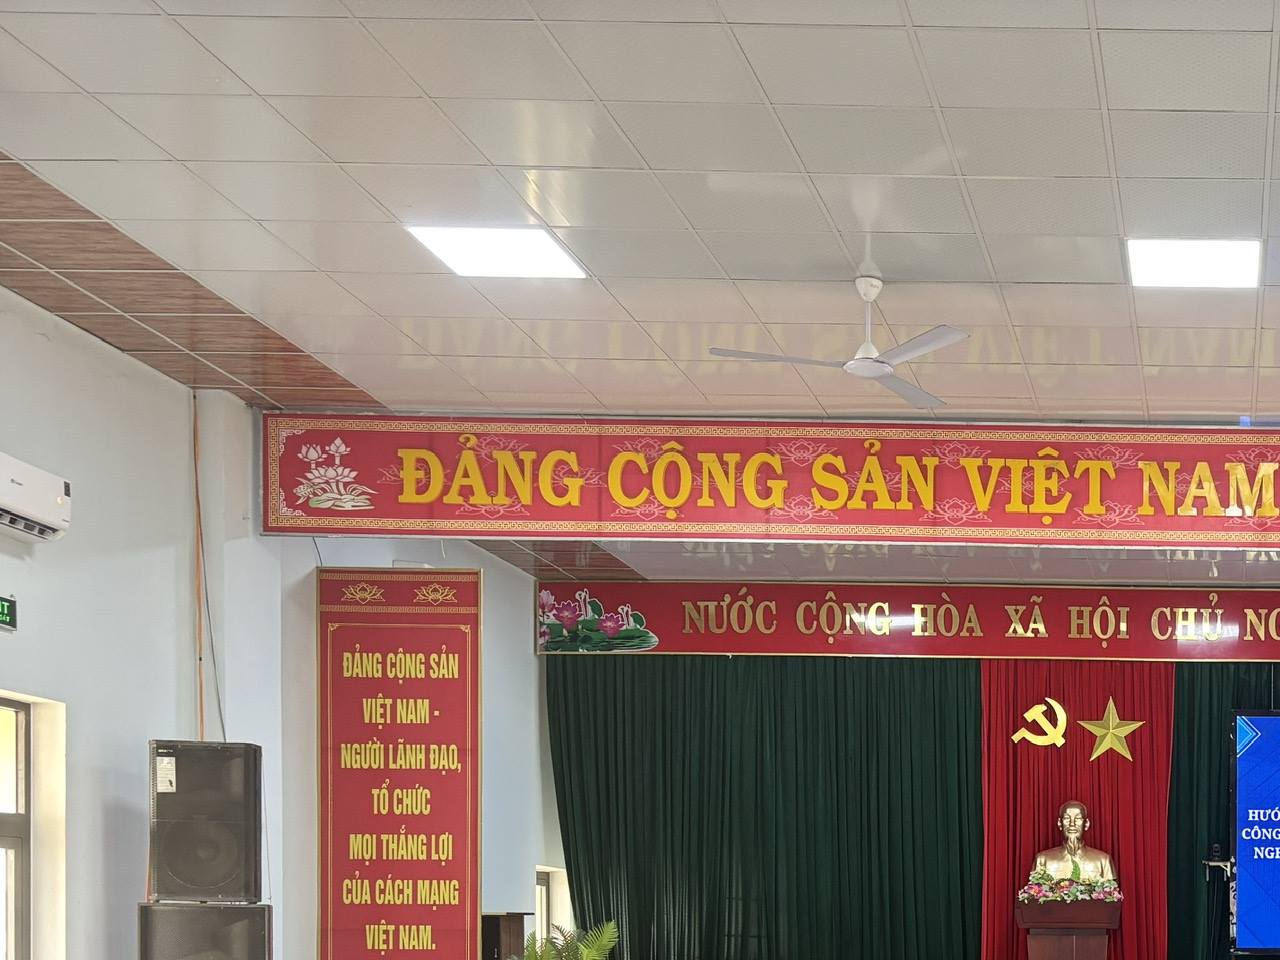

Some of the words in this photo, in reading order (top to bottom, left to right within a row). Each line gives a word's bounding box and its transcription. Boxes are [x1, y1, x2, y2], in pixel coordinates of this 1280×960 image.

[397, 434, 584, 508] ĐẢNG
[607, 441, 788, 520] CỘNG
[811, 440, 939, 512] SẢN
[959, 448, 1116, 526] VIỆT
[1136, 460, 1280, 517] NAM
[682, 591, 777, 634] NƯỚC
[795, 592, 893, 646] CỘNG
[911, 592, 983, 637] HÒA
[1005, 596, 1048, 639] XÃ
[1067, 594, 1130, 649] HỘI
[1150, 592, 1223, 642] CHỦ
[343, 644, 382, 678] ĐẢNG
[387, 648, 425, 684] CỘNG
[430, 645, 459, 679] SẢN
[363, 693, 393, 729] VIỆT
[397, 699, 430, 724] NAM
[341, 737, 385, 769] NGƯỜI
[389, 738, 425, 769] LÃNH
[429, 744, 461, 775] ĐẠO,
[372, 779, 390, 815] TỔ
[393, 784, 431, 815] CHỨC
[350, 834, 377, 865] MỌI
[381, 824, 427, 860] THẮNG
[431, 832, 453, 866] LỢI
[342, 870, 372, 905] CỦA
[375, 873, 413, 905] CÁCH
[417, 880, 460, 911] MẠNG
[366, 920, 395, 955] VIỆT
[399, 925, 437, 950] NAM.
